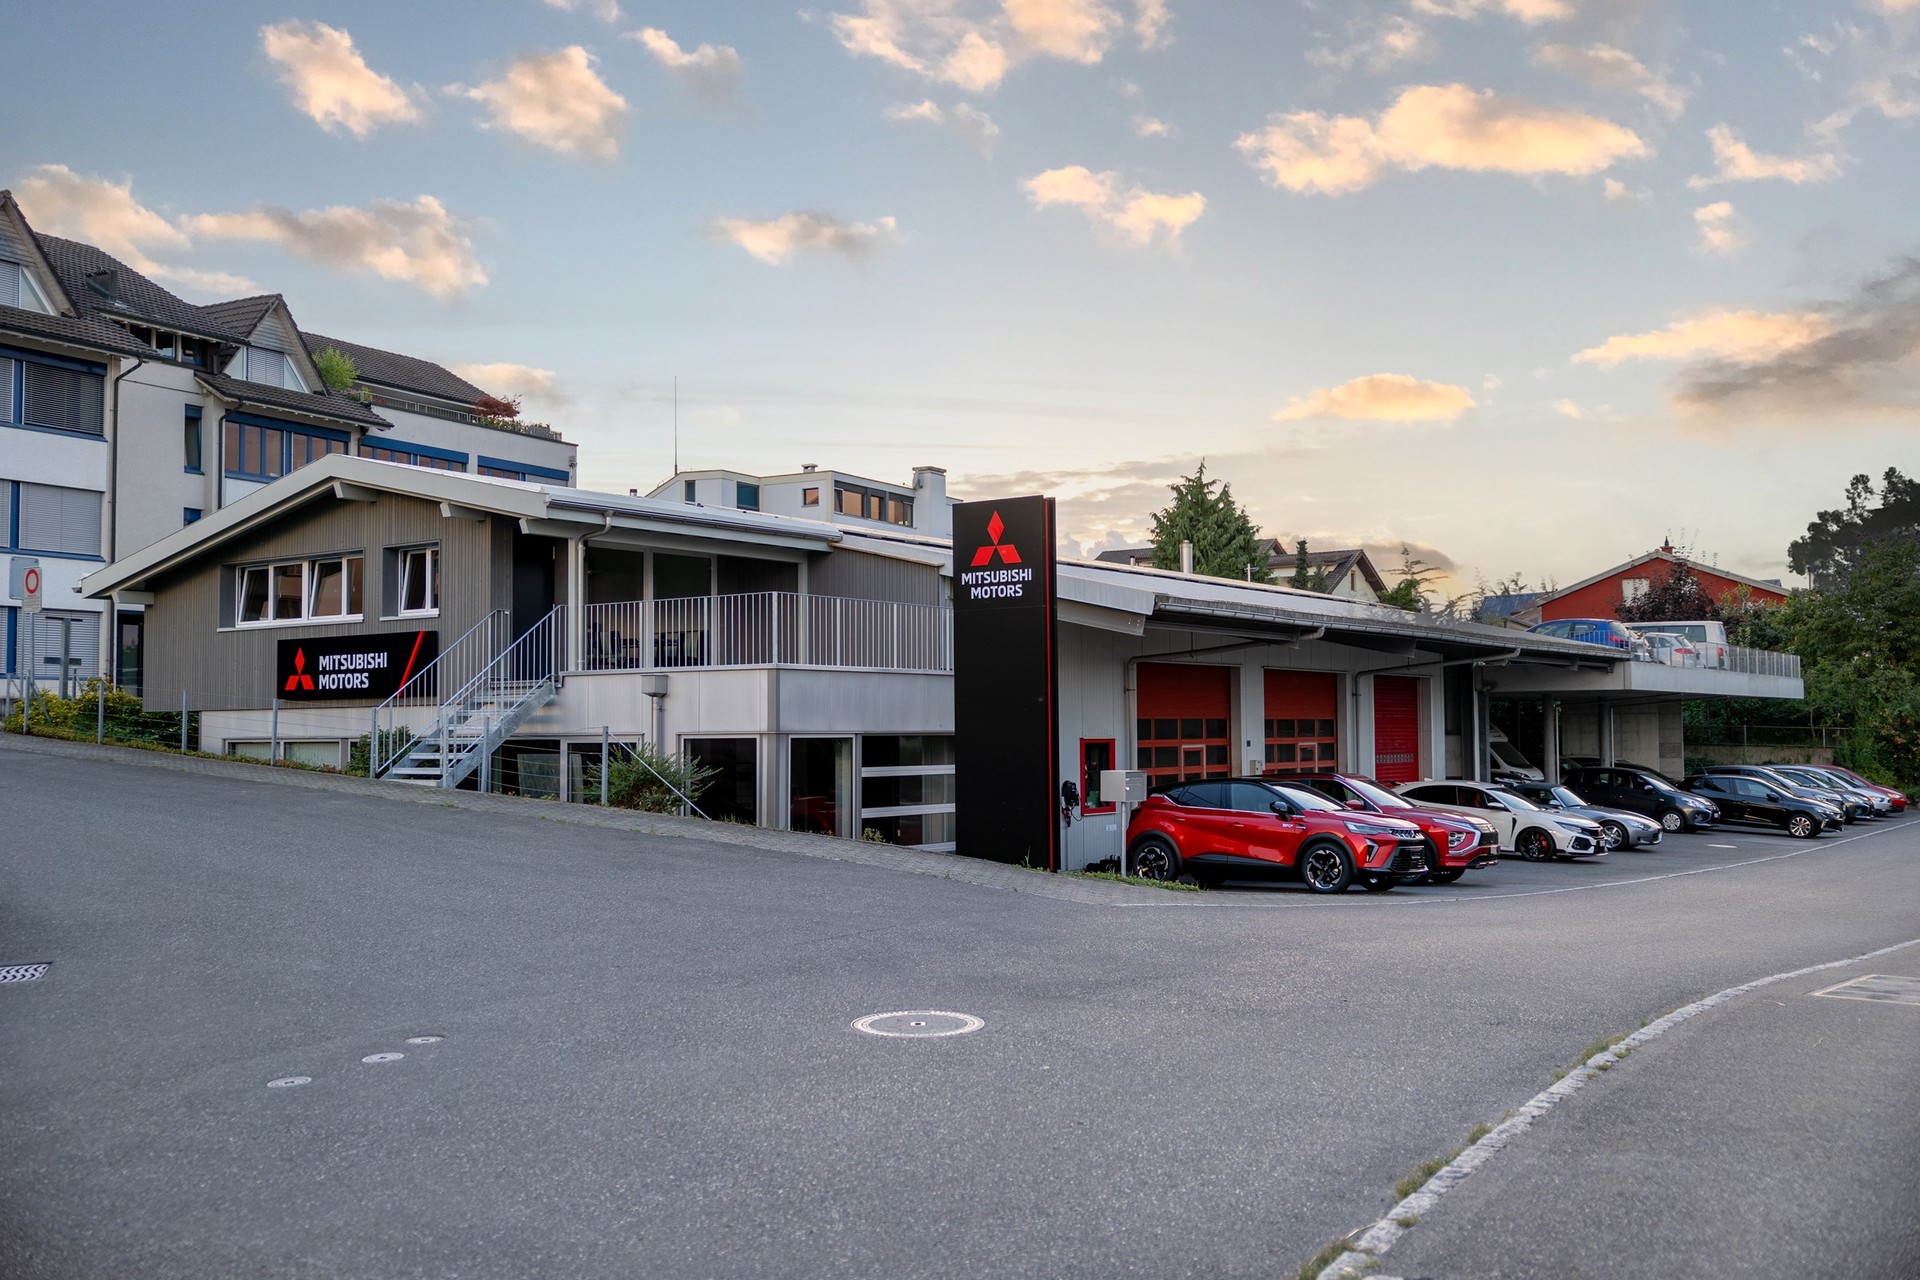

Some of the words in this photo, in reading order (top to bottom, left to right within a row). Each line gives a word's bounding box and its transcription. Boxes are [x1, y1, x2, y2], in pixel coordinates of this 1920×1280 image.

[961, 568, 1032, 585] MITSUBISHI
[971, 584, 1023, 599] MOTORS
[319, 652, 388, 671] MITSUBISHI
[319, 673, 369, 690] MOTORS
